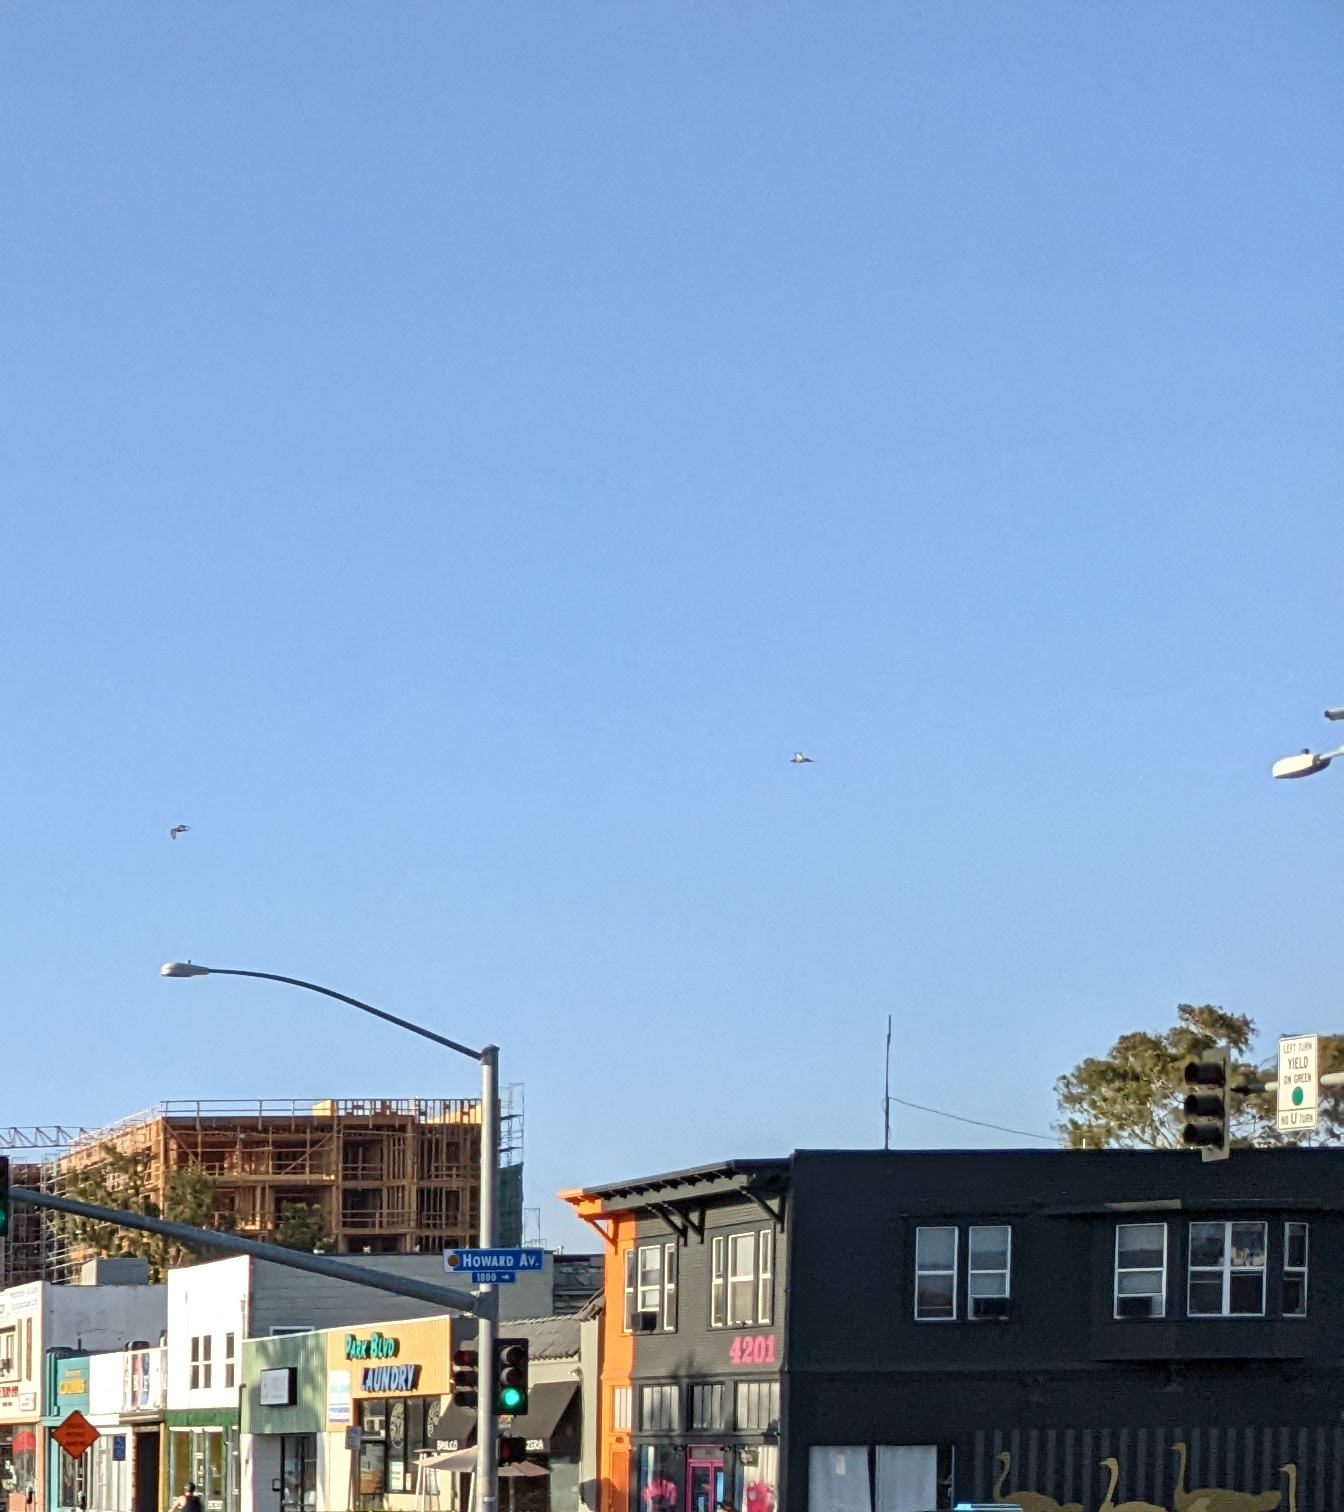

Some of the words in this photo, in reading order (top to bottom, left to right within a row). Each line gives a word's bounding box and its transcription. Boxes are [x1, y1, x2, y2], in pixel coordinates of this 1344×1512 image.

[1283, 1043, 1296, 1054] LEFT
[1299, 1042, 1312, 1052] TURN
[1288, 1056, 1309, 1070] YIELD
[1284, 1075, 1292, 1085] ON
[1294, 1073, 1312, 1084] GREEN
[1281, 1115, 1289, 1126] NO
[1290, 1112, 1298, 1125] U
[1299, 1113, 1313, 1124] TURN
[462, 1253, 514, 1268] HOWARD
[476, 1272, 497, 1282] 1800
[345, 1334, 368, 1360] PARK
[370, 1332, 396, 1360] BLVD
[729, 1334, 778, 1365] 4201
[360, 1364, 416, 1392] LAUNDRY
